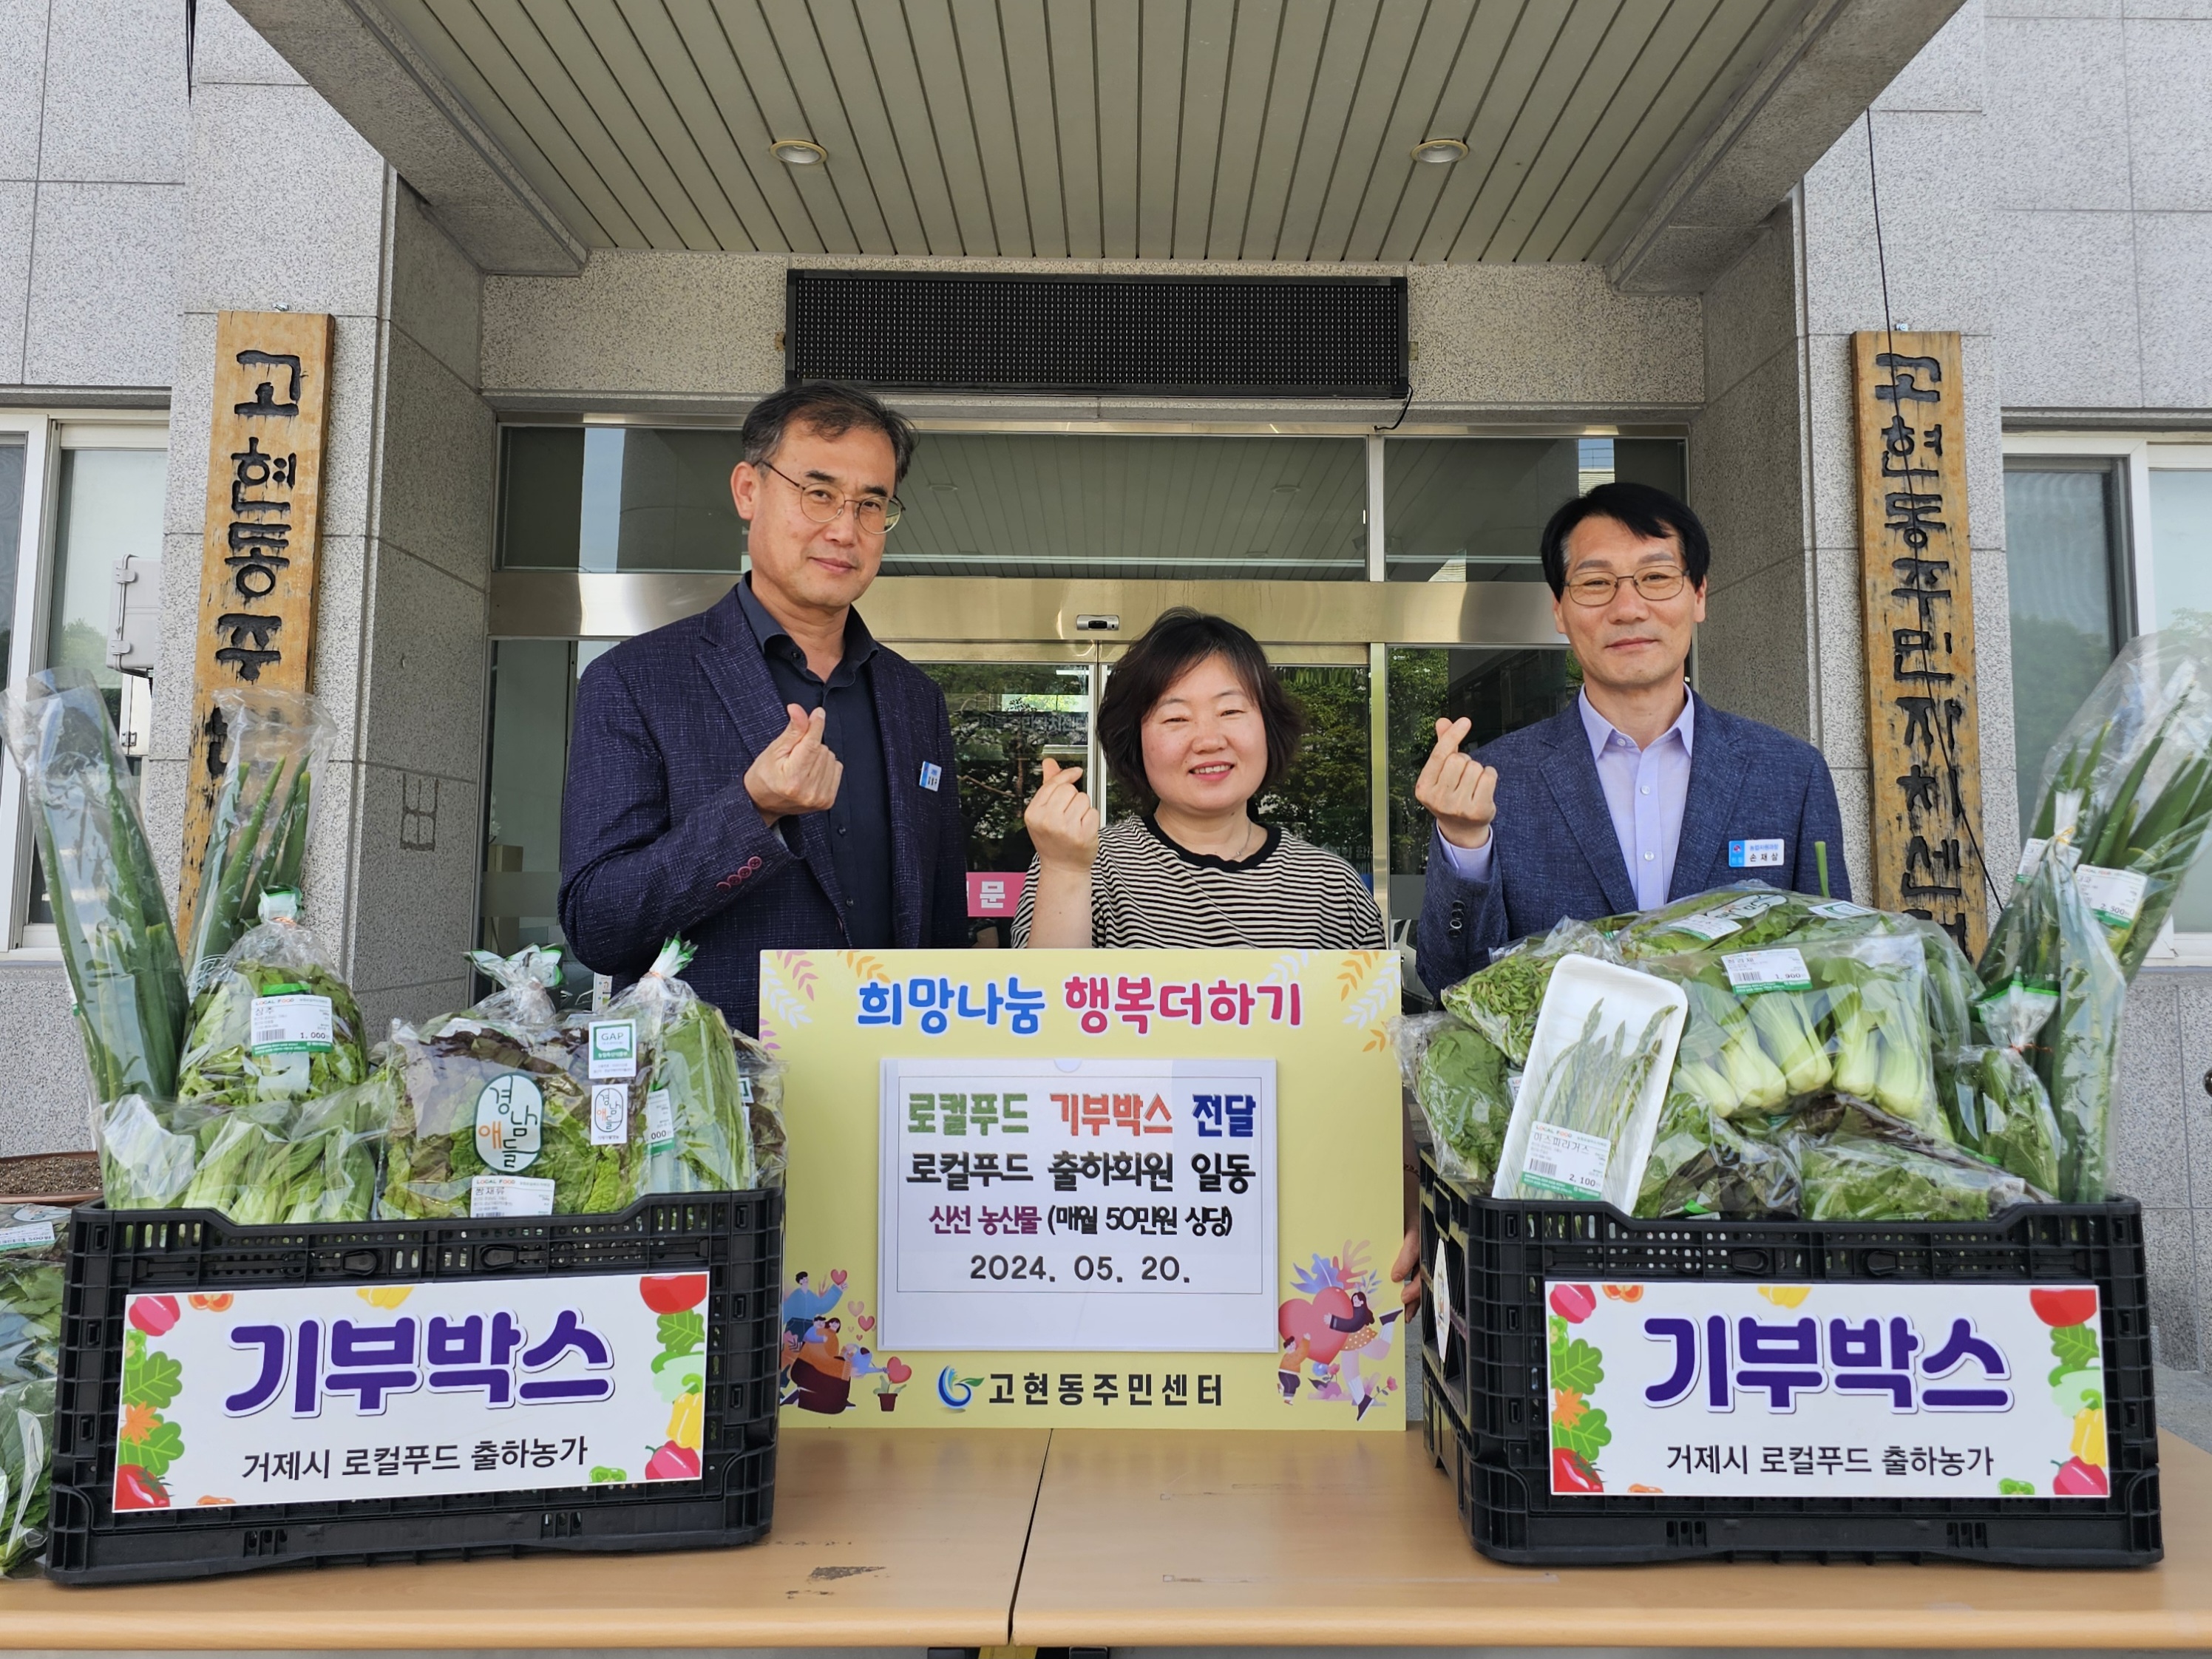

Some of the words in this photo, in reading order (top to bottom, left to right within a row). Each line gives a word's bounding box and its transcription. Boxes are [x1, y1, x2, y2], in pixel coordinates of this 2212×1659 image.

[966, 881, 1005, 909] 문
[858, 977, 1045, 1034] 희망나눔
[1065, 977, 1300, 1034] 행복더하기
[601, 1032, 624, 1041] GAP
[908, 1093, 1028, 1136] 로컬푸드
[1050, 1093, 1173, 1137] 기부박스
[1192, 1093, 1257, 1138] 전달
[1534, 1133, 1590, 1155] 아스파라거스
[906, 1151, 1033, 1191] 로컬푸드
[1048, 1150, 1173, 1192] 출하회원
[1191, 1152, 1256, 1195] 일동
[928, 1205, 971, 1235] 신선
[977, 1205, 1042, 1236] 농산물
[1047, 1204, 1098, 1235] (매월
[1105, 1206, 1178, 1235] 50만원
[1184, 1206, 1233, 1237] 상당)
[970, 1255, 1056, 1283] 2024.
[1074, 1255, 1123, 1283] 05.
[1141, 1256, 1190, 1283] 20.
[226, 1310, 608, 1412] 기부박스
[1644, 1315, 2008, 1408] 기부박스
[988, 1371, 1221, 1406] 고현동주민센터
[242, 1449, 330, 1482] 거제시
[342, 1445, 461, 1476] 로컬푸드
[471, 1436, 588, 1471] 출하농가
[1667, 1445, 1748, 1476] 거제시
[1760, 1446, 1872, 1476] 로컬푸드
[1882, 1446, 1994, 1476] 출하농가
